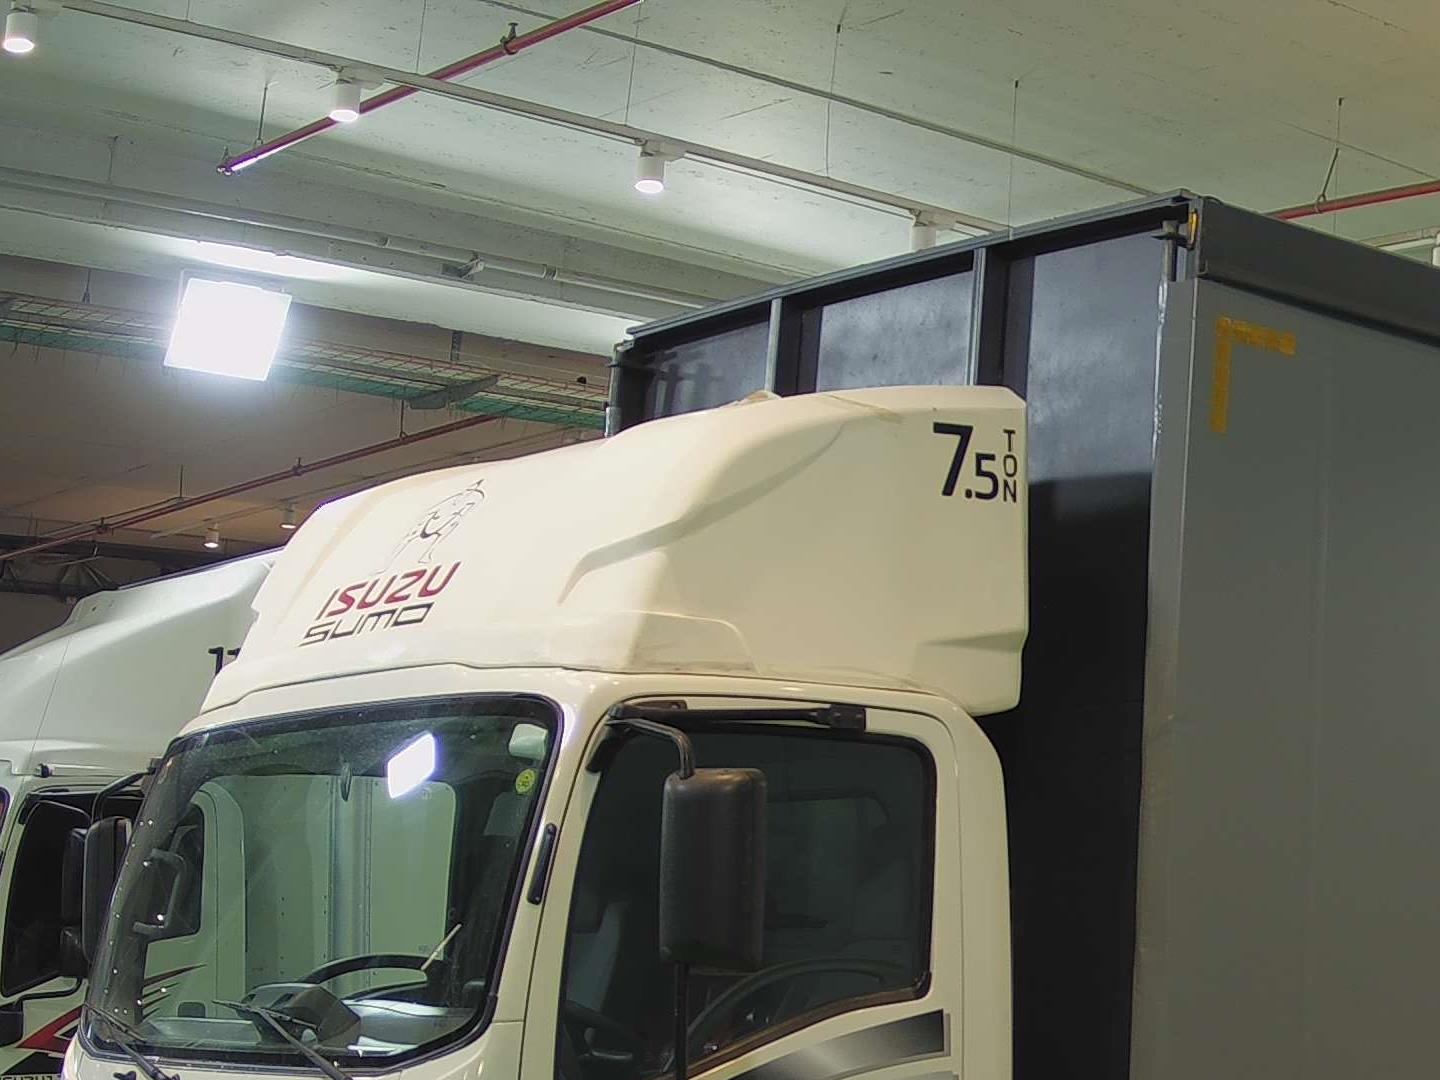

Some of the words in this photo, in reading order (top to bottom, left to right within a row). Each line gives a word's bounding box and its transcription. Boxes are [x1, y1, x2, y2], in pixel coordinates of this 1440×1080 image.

[932, 421, 1000, 501] 7.5
[1003, 428, 1018, 503] TON
[315, 561, 462, 621] ISUZU
[297, 602, 434, 647] SUMO
